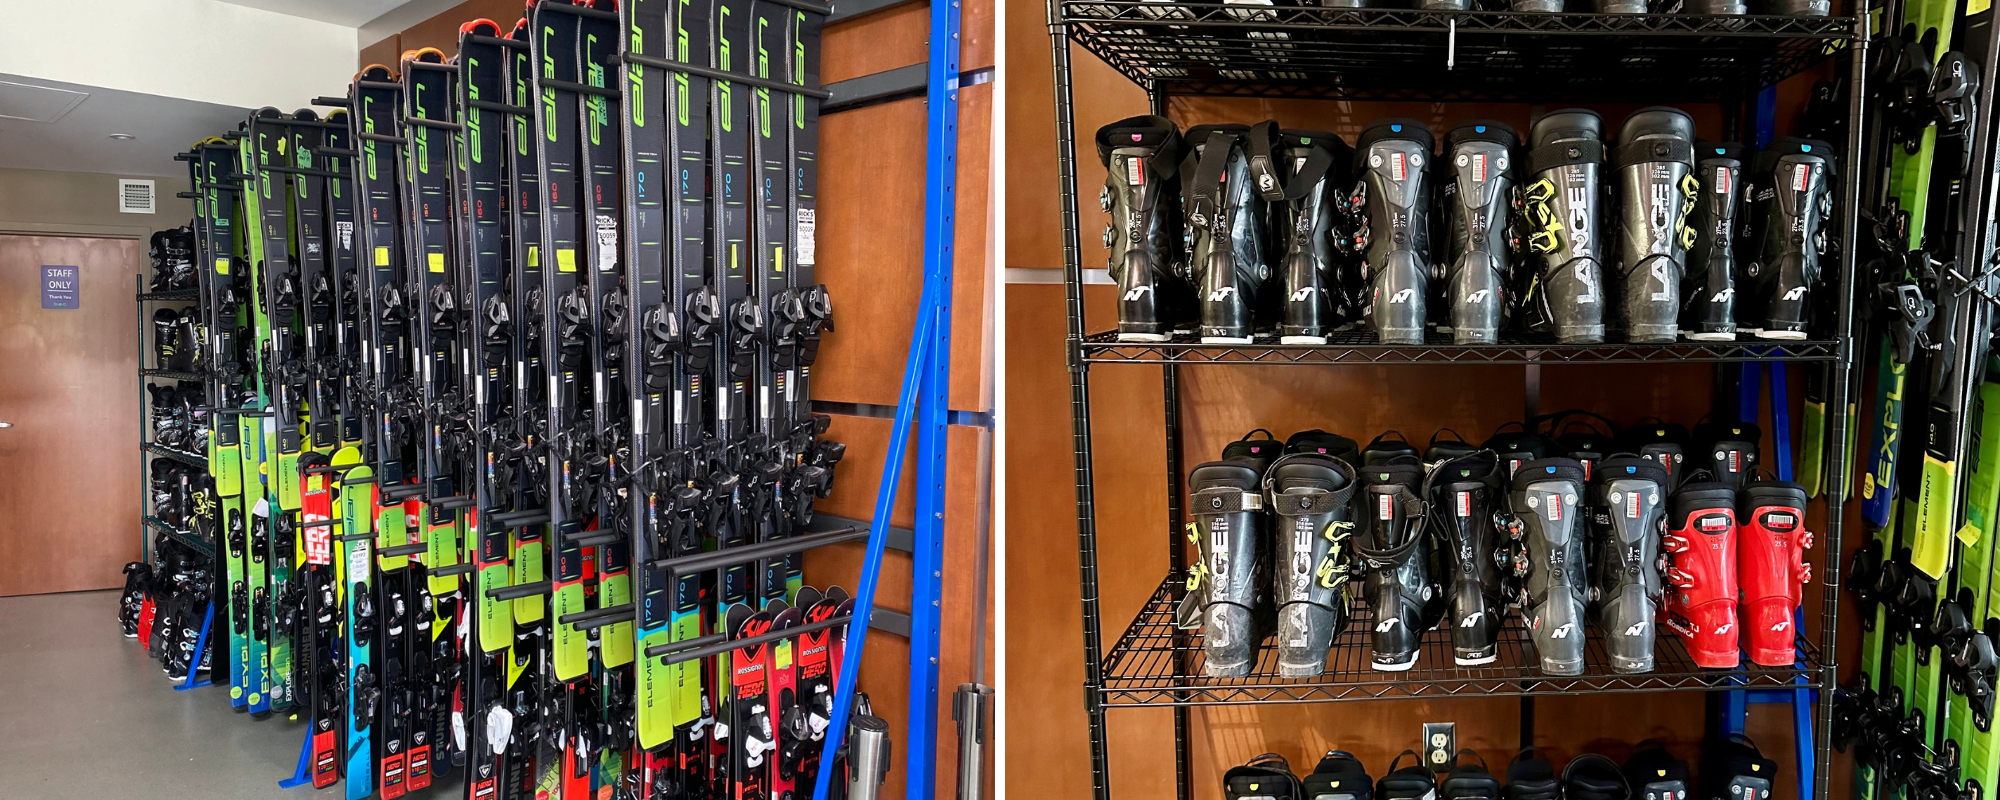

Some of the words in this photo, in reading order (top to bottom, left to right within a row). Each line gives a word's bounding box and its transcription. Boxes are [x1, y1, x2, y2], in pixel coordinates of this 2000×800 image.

[542, 26, 557, 142] elan
[586, 34, 600, 146] elan
[415, 82, 428, 174] elan
[467, 57, 482, 163] elan
[364, 96, 377, 181] elan
[259, 133, 271, 199] elan
[1568, 187, 1595, 303] LANGE
[1651, 183, 1671, 302] LANGE
[47, 269, 73, 278] STAFF
[48, 280, 72, 289] ONLY
[1922, 471, 1931, 531] ELEMENT
[1211, 531, 1230, 648] LANGE
[1289, 531, 1313, 648] LANGE
[301, 627, 310, 676] TUNNER
[802, 645, 827, 657] ROSSIGNOL
[1666, 618, 1695, 639] NORDICA
[1689, 622, 1700, 633] TJ
[737, 681, 765, 700] HERO
[738, 663, 764, 675] ROSSIGNOL
[802, 662, 827, 680] HERO
[319, 752, 333, 760] HERO
[436, 703, 445, 760] STUNNE
[387, 762, 400, 771] HERO
[413, 753, 426, 762] HERO
[477, 780, 493, 790] HERO
